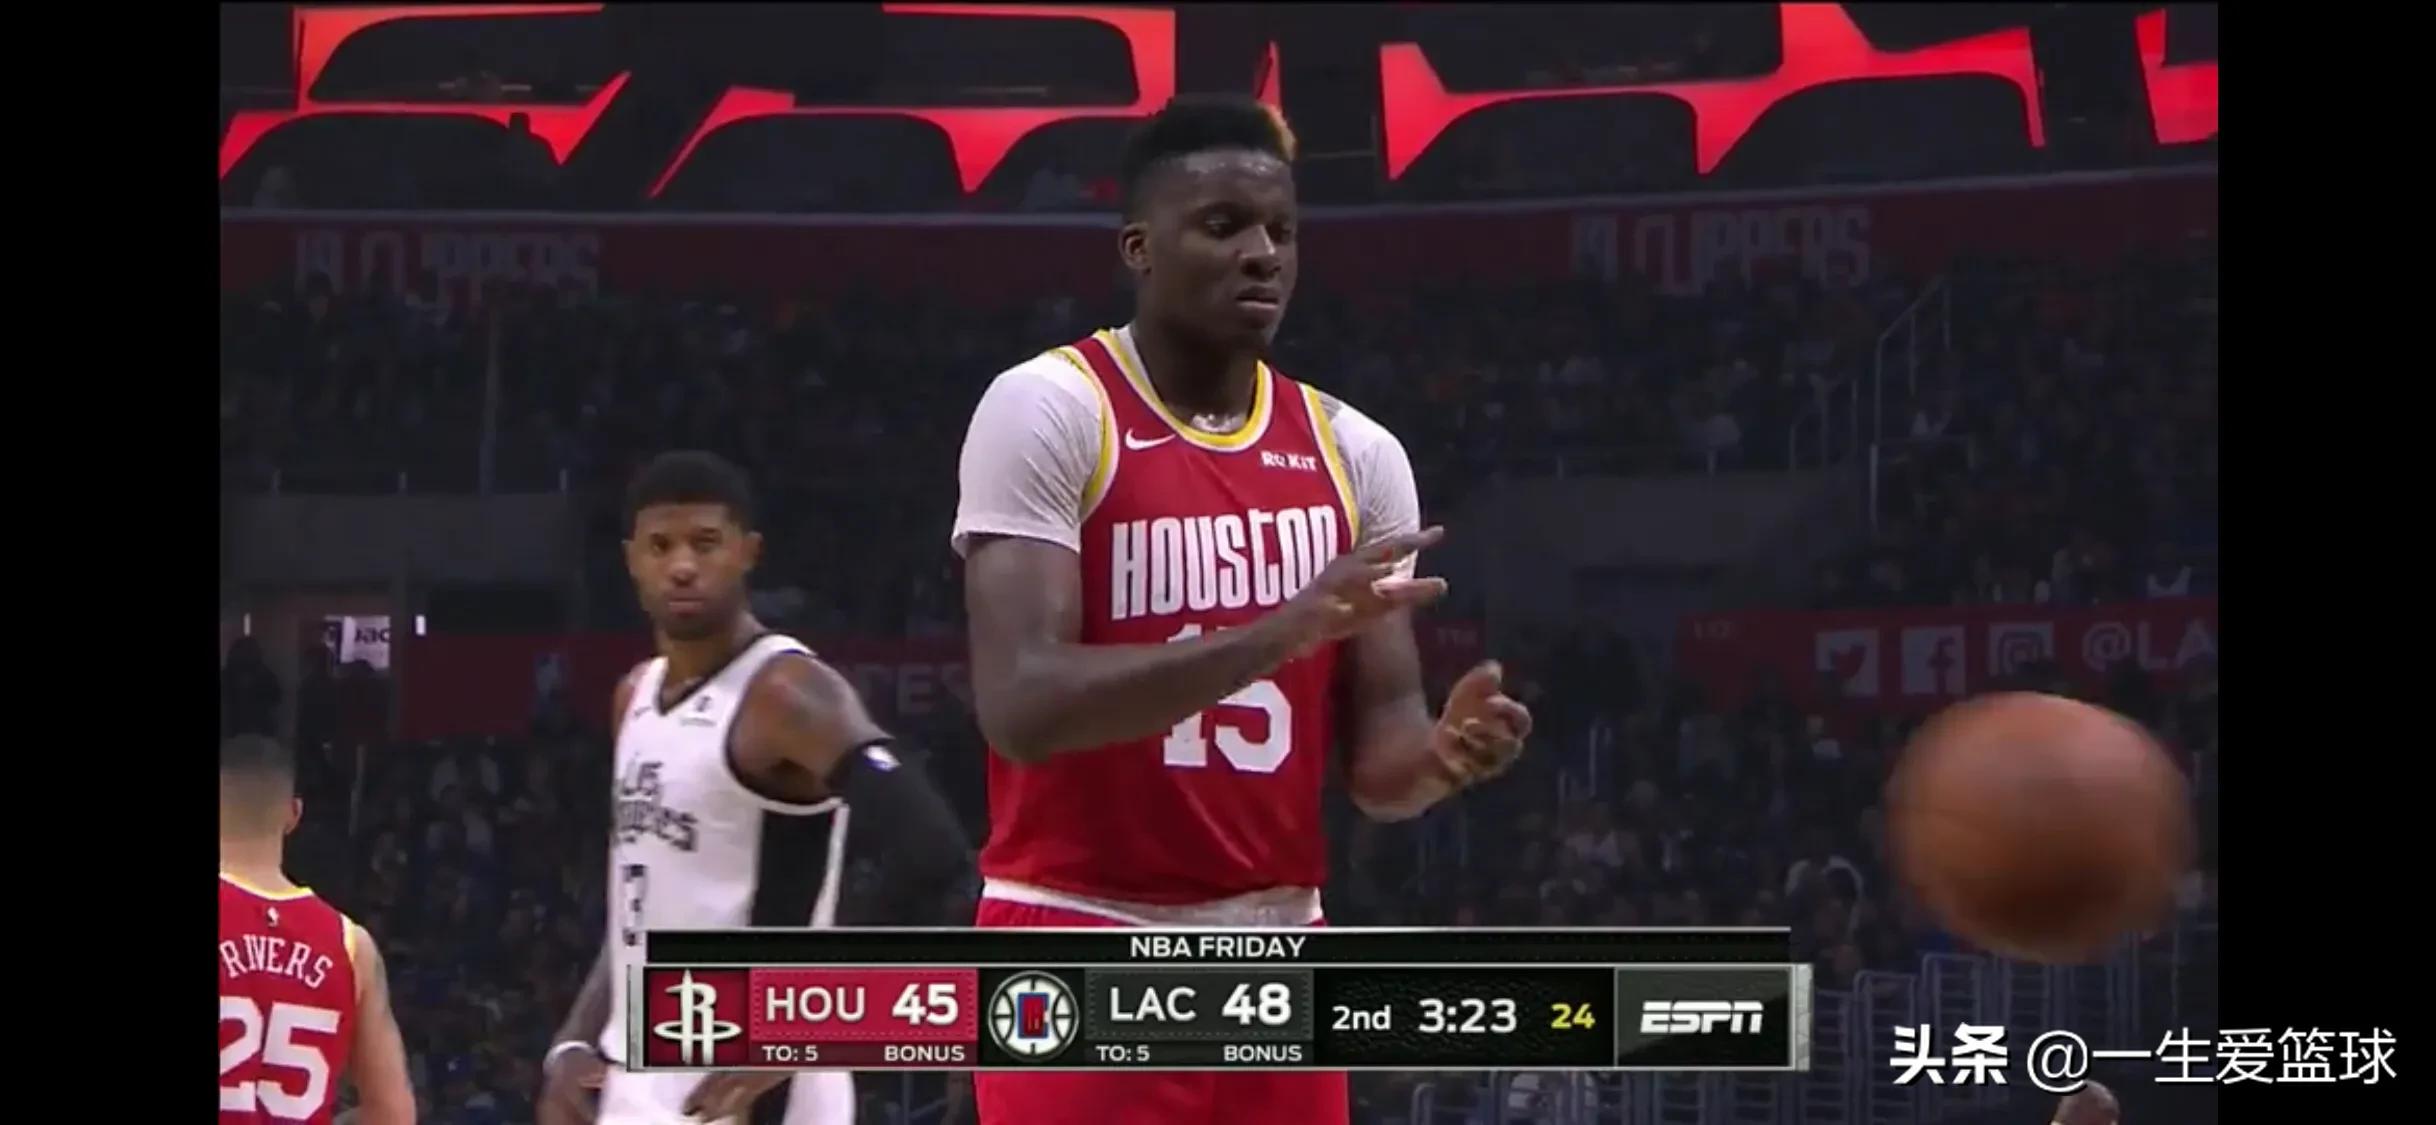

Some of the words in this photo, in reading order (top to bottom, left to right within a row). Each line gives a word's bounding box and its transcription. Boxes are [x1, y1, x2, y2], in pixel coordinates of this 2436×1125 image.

[1111, 505, 1338, 620] HOUSTON
[219, 934, 333, 989] RIVERS
[219, 996, 342, 1121] 25
